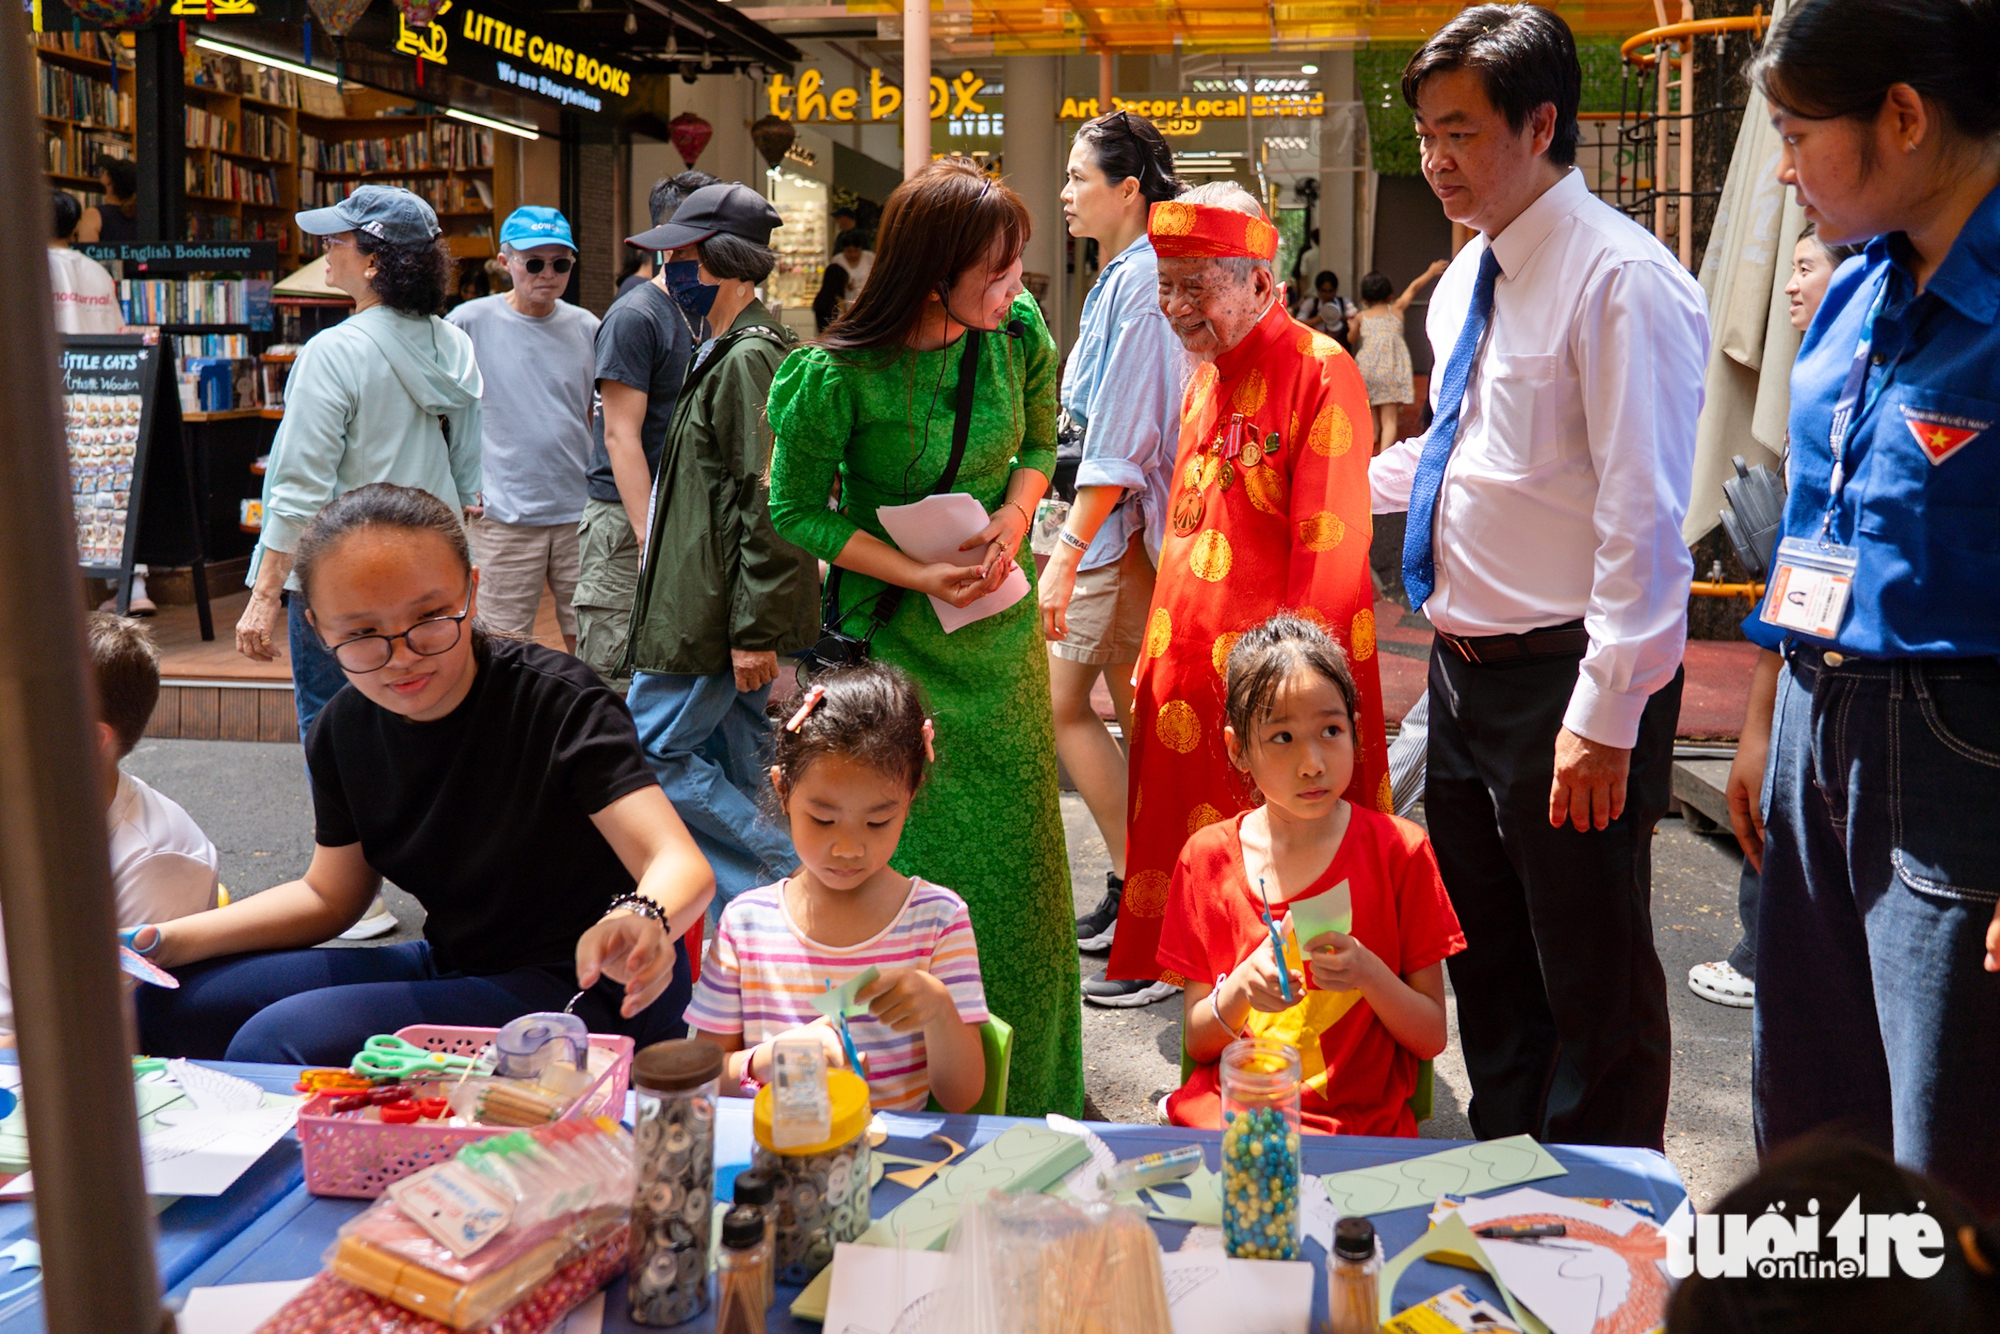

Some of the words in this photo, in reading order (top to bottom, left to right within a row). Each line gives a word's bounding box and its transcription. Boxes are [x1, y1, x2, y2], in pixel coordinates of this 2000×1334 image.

[463, 9, 526, 58] LITTLE
[528, 35, 575, 75] CATS
[575, 53, 631, 97] BOOKS
[496, 61, 517, 84] We
[518, 72, 538, 91] are
[538, 75, 602, 112] Storytellers
[767, 68, 859, 121] the
[1060, 97, 1099, 118] Art
[1181, 96, 1246, 117] Local
[1251, 92, 1325, 117] Brand
[85, 245, 116, 259] Cats
[121, 245, 171, 263] English
[175, 245, 251, 259] Bookstore
[102, 354, 138, 370] CATS
[101, 376, 140, 391] Wooden
